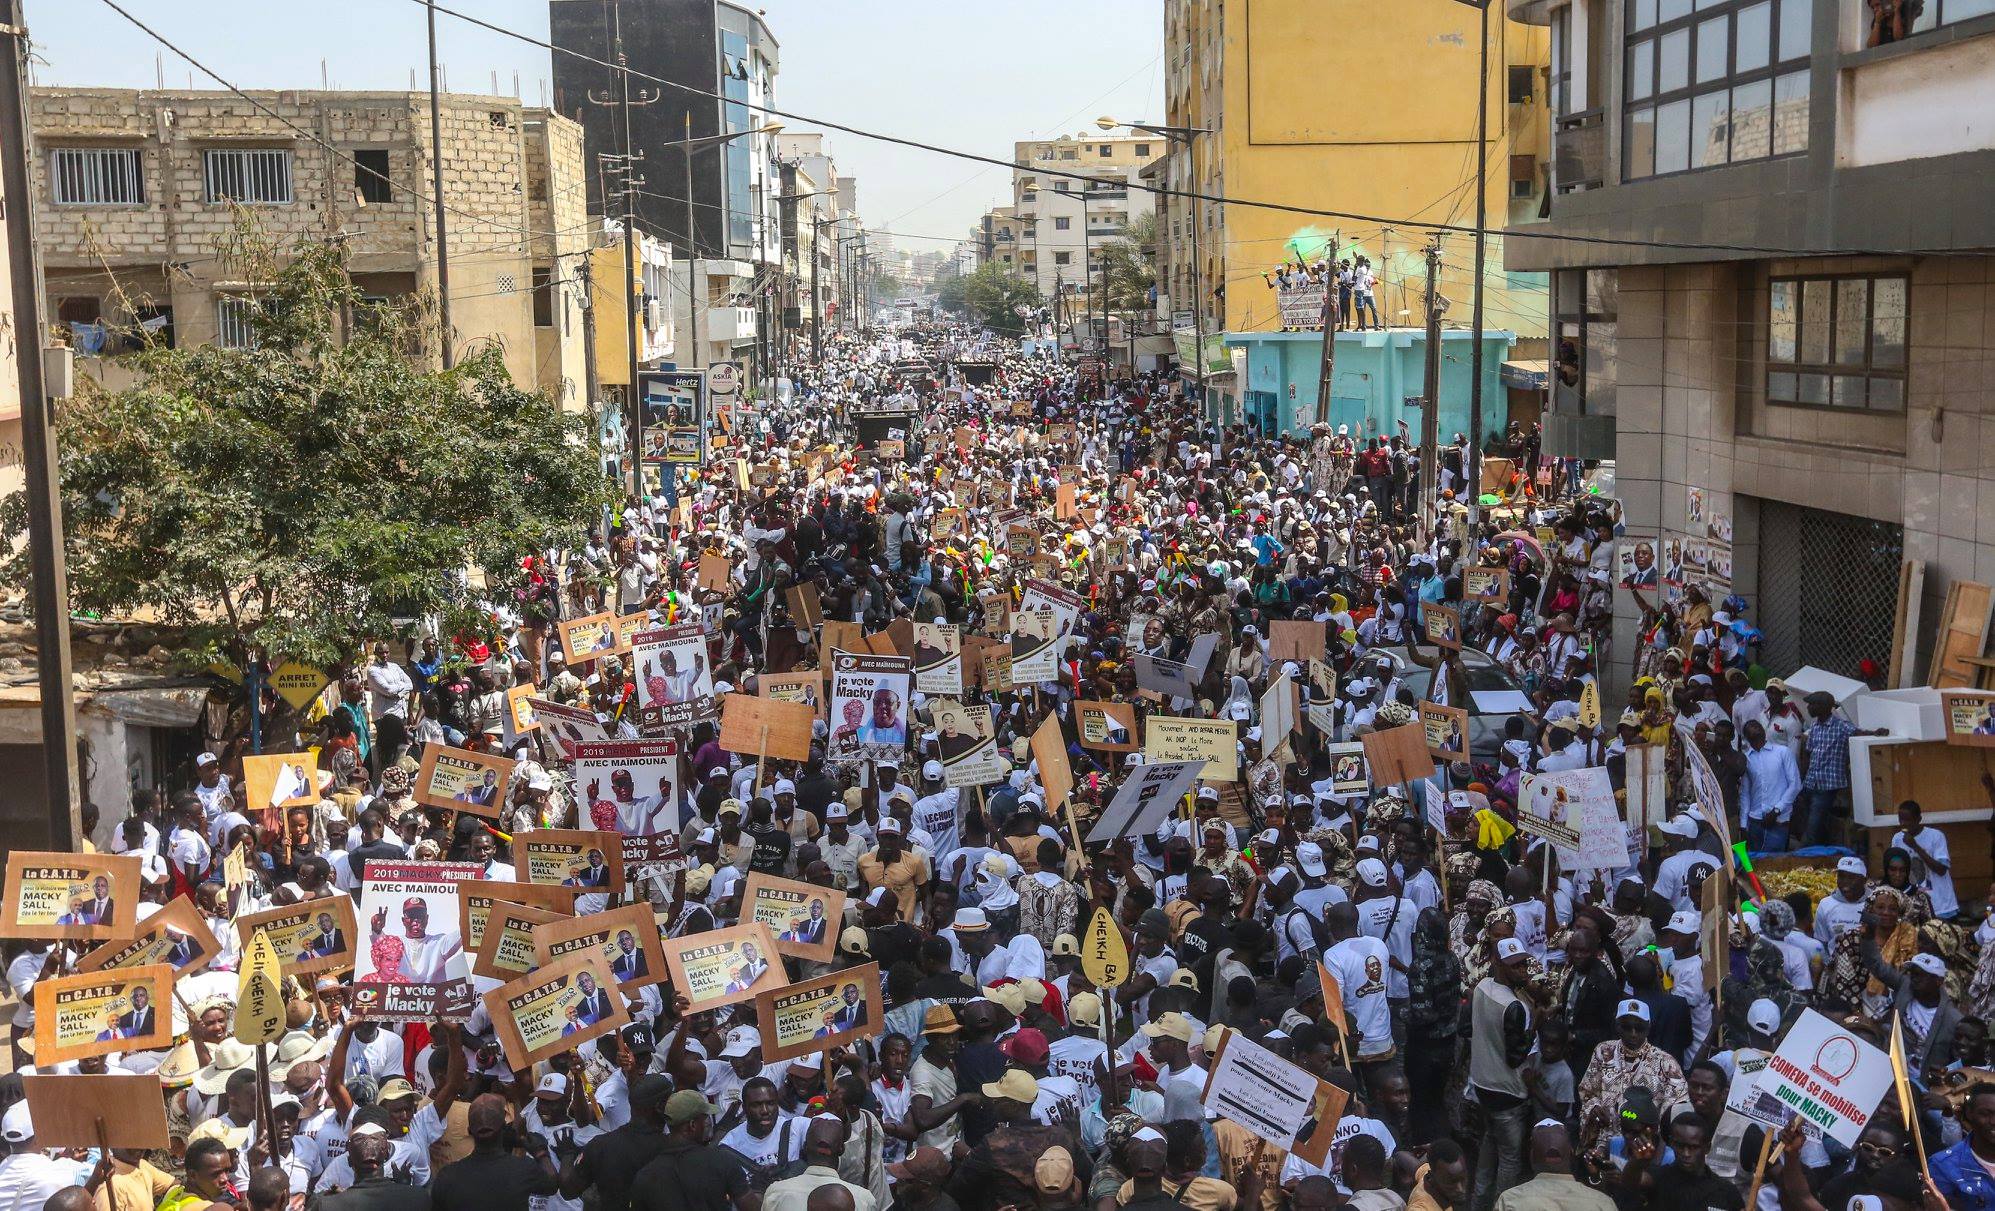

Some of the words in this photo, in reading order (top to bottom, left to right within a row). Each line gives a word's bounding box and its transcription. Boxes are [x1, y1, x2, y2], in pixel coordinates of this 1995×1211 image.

[675, 378, 698, 387] Hertz
[1029, 590, 1043, 599] AVEC
[637, 635, 653, 643] 2019
[638, 643, 657, 652] AVEC
[658, 637, 699, 649] MAÏMOUNA
[278, 673, 317, 682] ARRET
[837, 675, 848, 687] je
[851, 677, 875, 686] vote
[278, 681, 298, 689] MINI
[300, 681, 318, 689] BUS
[836, 686, 874, 701] Macky
[662, 705, 670, 714] je
[672, 701, 692, 711] vote
[963, 705, 988, 713] AVEC
[662, 711, 693, 723] Macky
[1588, 712, 1596, 726] BA
[583, 748, 605, 756] 2019
[639, 745, 668, 754] PRESIDENT
[583, 759, 609, 767] AVEC
[611, 756, 668, 767] MAÏMOUNA
[1207, 754, 1220, 763] SALL
[1148, 766, 1159, 774] je
[1162, 764, 1184, 772] vote
[435, 772, 461, 783] MACKY
[1142, 772, 1180, 782] Macky
[622, 837, 649, 846] vote
[529, 844, 539, 852] La
[540, 844, 575, 854] C.A.T.B.
[622, 848, 649, 861] cky
[531, 861, 561, 869] MACKY
[25, 869, 37, 879] La
[39, 868, 82, 880] C.A.T.B.
[373, 868, 399, 878] 2019
[531, 867, 555, 876] SALL,
[1695, 867, 1706, 879] NY
[371, 883, 402, 893] AVEC
[405, 883, 458, 894] MAÏMOU
[1167, 888, 1176, 896] LA
[23, 892, 61, 900] MACKY
[758, 889, 768, 898] La
[769, 889, 800, 902] C.A.T.B.
[22, 901, 51, 910] SALL,
[471, 898, 481, 907] La
[756, 909, 785, 919] MACKY
[267, 915, 304, 931] C.A.T.B.
[507, 919, 518, 929] La
[502, 939, 536, 953] MACKY
[552, 945, 564, 955] La
[564, 934, 603, 951] C.A.T.B.
[1096, 912, 1107, 960] CHEIKH
[1104, 963, 1117, 983] BA
[104, 960, 116, 970] La
[114, 938, 152, 962] C.A.T.B.
[500, 946, 525, 960] SALL,
[682, 952, 694, 962] La
[693, 944, 729, 959] C.A.T.B.
[689, 966, 720, 980] MACKY
[691, 976, 716, 988] SALL,
[60, 995, 72, 1003] La
[73, 985, 116, 1001] C.A.T.B.
[386, 984, 401, 998] je
[404, 985, 437, 996] vote
[511, 999, 523, 1010] La
[523, 981, 563, 1004] C.A.T.B.
[777, 1000, 788, 1009] La
[789, 988, 829, 1005] C.A.T.B.
[251, 975, 264, 1017] CHEIKH
[263, 1017, 278, 1036] BA
[384, 997, 435, 1015] Macky
[60, 1010, 98, 1024] MACKY
[520, 1008, 555, 1029] MACKY
[779, 1012, 814, 1026] MACKY
[60, 1023, 88, 1032] SALL,
[523, 1022, 550, 1037] SALL,
[779, 1023, 806, 1034] SALL,
[633, 1031, 645, 1044] NY
[1254, 1052, 1262, 1060] Les
[1056, 1058, 1067, 1070] je
[1072, 1060, 1094, 1070] vot
[1230, 1067, 1244, 1078] pour
[1244, 1074, 1257, 1085] aller
[1256, 1082, 1272, 1094] voter
[1272, 1090, 1294, 1108] Macky
[1769, 1055, 1810, 1090] COMEVA
[1806, 1080, 1821, 1096] se
[1819, 1089, 1868, 1126] mobilise
[1775, 1084, 1802, 1107] pour
[1800, 1097, 1838, 1130] MACKY
[1217, 1102, 1231, 1113] pour
[1244, 1116, 1260, 1128] voter
[1260, 1124, 1281, 1140] Macky
[1332, 1123, 1361, 1139] NNO
[328, 1139, 339, 1147] LES
